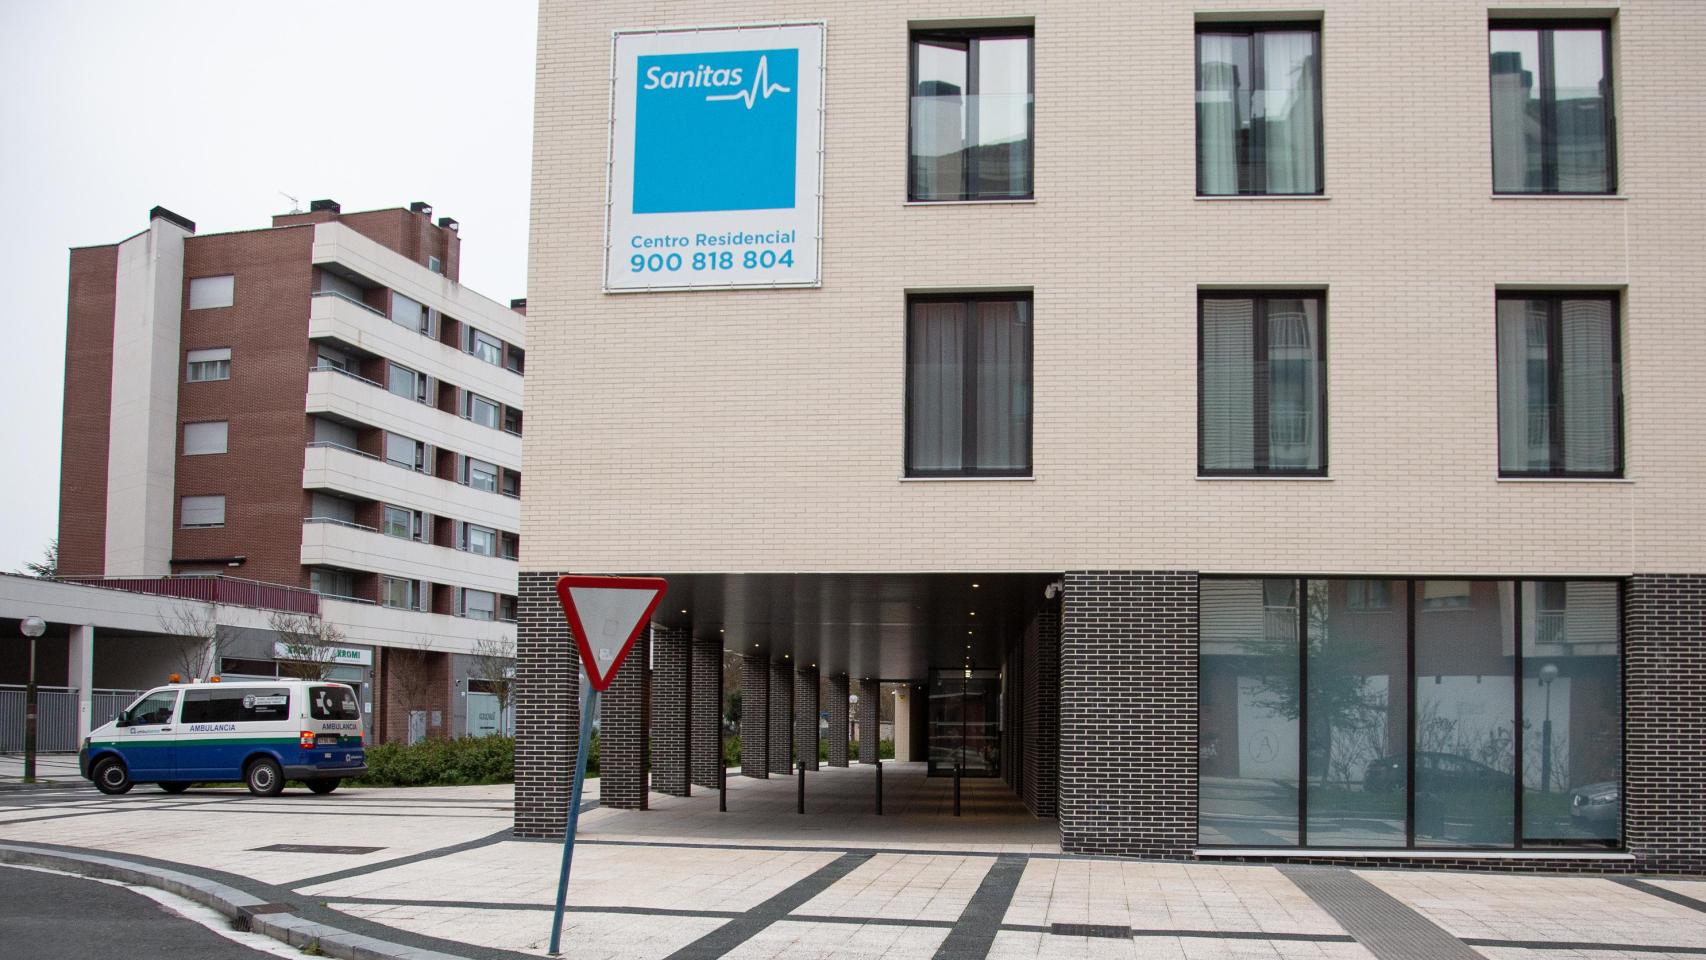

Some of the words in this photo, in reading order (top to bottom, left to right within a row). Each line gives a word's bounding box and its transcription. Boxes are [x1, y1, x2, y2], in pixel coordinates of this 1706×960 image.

[644, 65, 743, 90] Sanitas
[631, 235, 690, 249] Centro
[695, 229, 796, 247] Residencial
[630, 252, 683, 273] 900
[691, 250, 734, 271] 818
[742, 248, 795, 270] 804
[189, 724, 236, 732] AMBULANCIA
